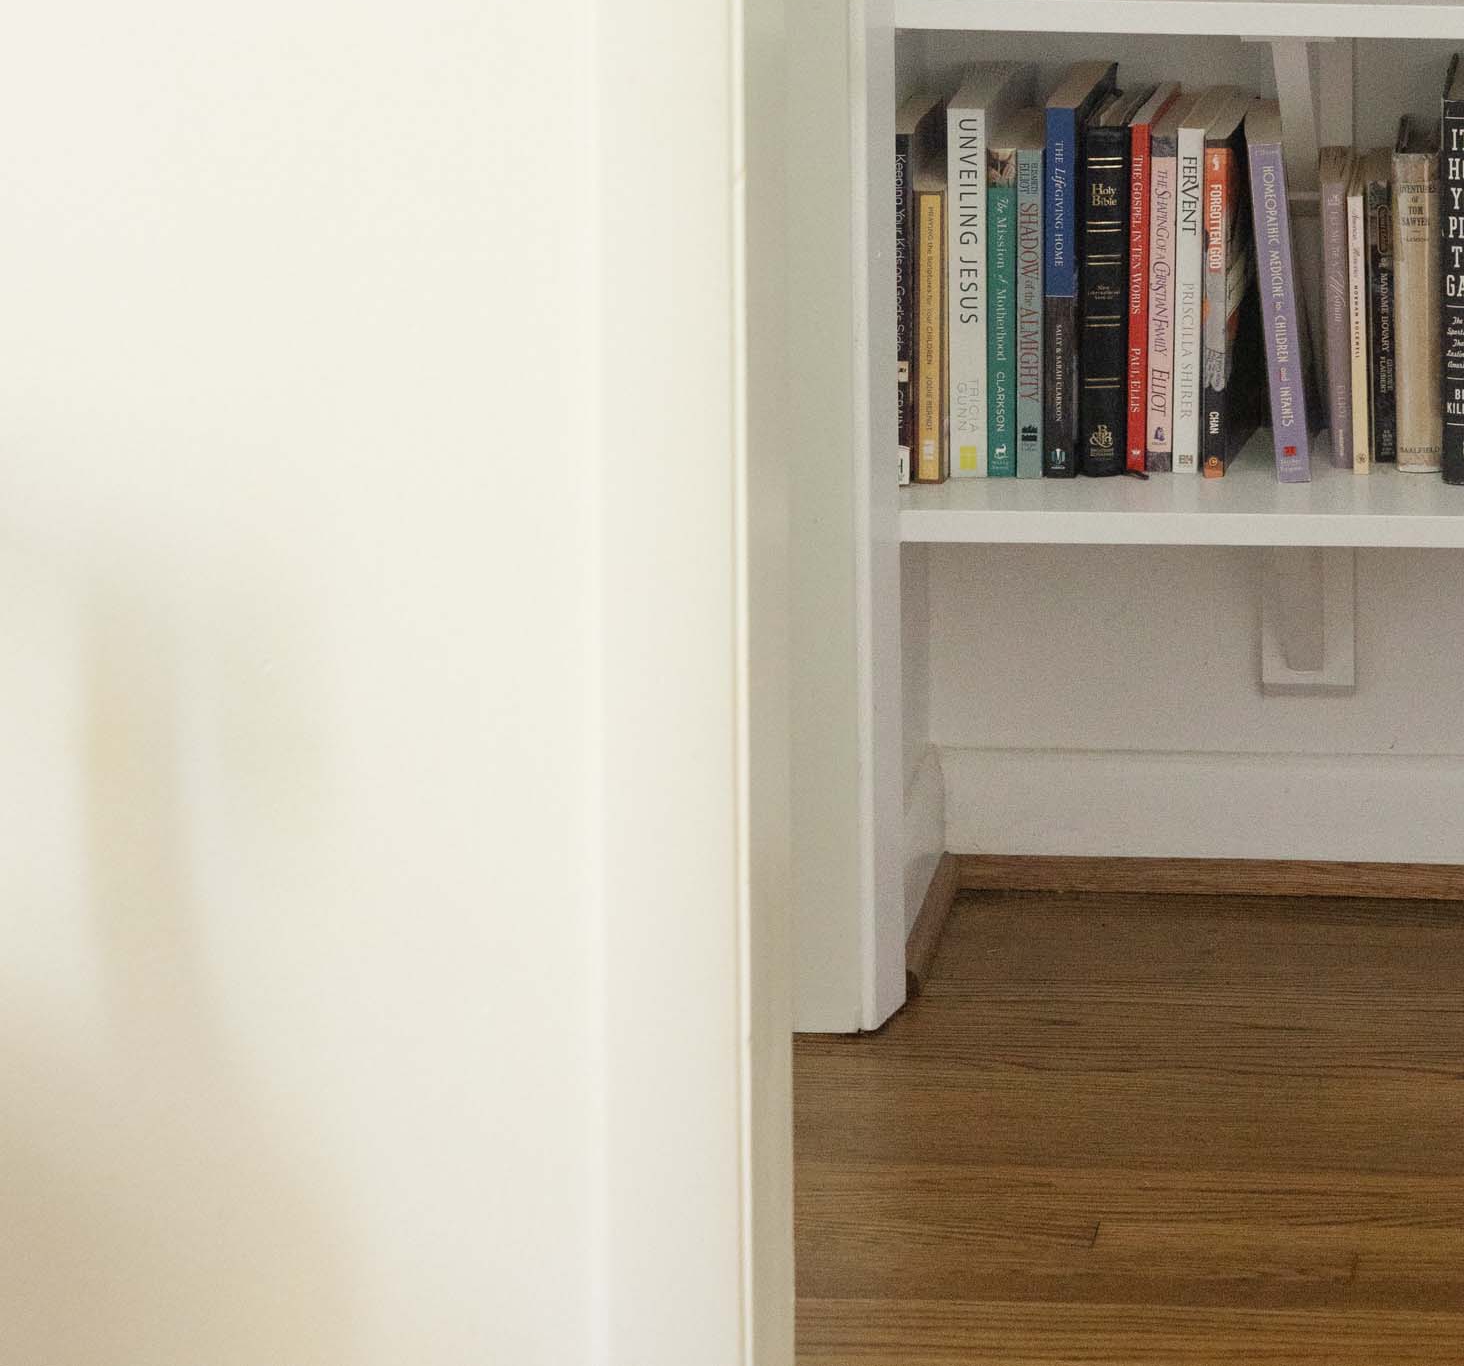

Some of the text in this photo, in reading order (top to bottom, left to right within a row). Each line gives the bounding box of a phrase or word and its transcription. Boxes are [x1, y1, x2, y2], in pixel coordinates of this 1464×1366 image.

[1019, 163, 1030, 194] ELLIOT
[1055, 140, 1064, 267] THE HOME
[1092, 183, 1117, 196] Holy
[1092, 195, 1117, 206] Bible
[1181, 156, 1199, 236] FERVENT
[959, 118, 978, 324] UNVEILING JESUS
[1131, 155, 1144, 315] THE GOSPEL TEN WORDS
[1209, 184, 1222, 269] FORGOTTEN GOD
[996, 216, 1007, 360] Mission Motherhood
[1020, 203, 1039, 403] SHADOW ALMIGHTY
[1150, 188, 1172, 357] SHAPING CHRISTIAN FAMILY
[1263, 166, 1294, 427] HOMEOPATHIC MEDICINE CHILDREN INFANTS
[1180, 283, 1194, 420] PRISCILLA SHIRER
[1380, 273, 1390, 352] MADAME BOVARY
[957, 382, 968, 431] GUNN
[969, 380, 979, 433] TRICIA
[996, 371, 1005, 432] CLARKSON
[1131, 348, 1142, 413] PAUL ELLIS
[1151, 368, 1170, 417] ELLIOT
[1209, 411, 1219, 434] CHAN
